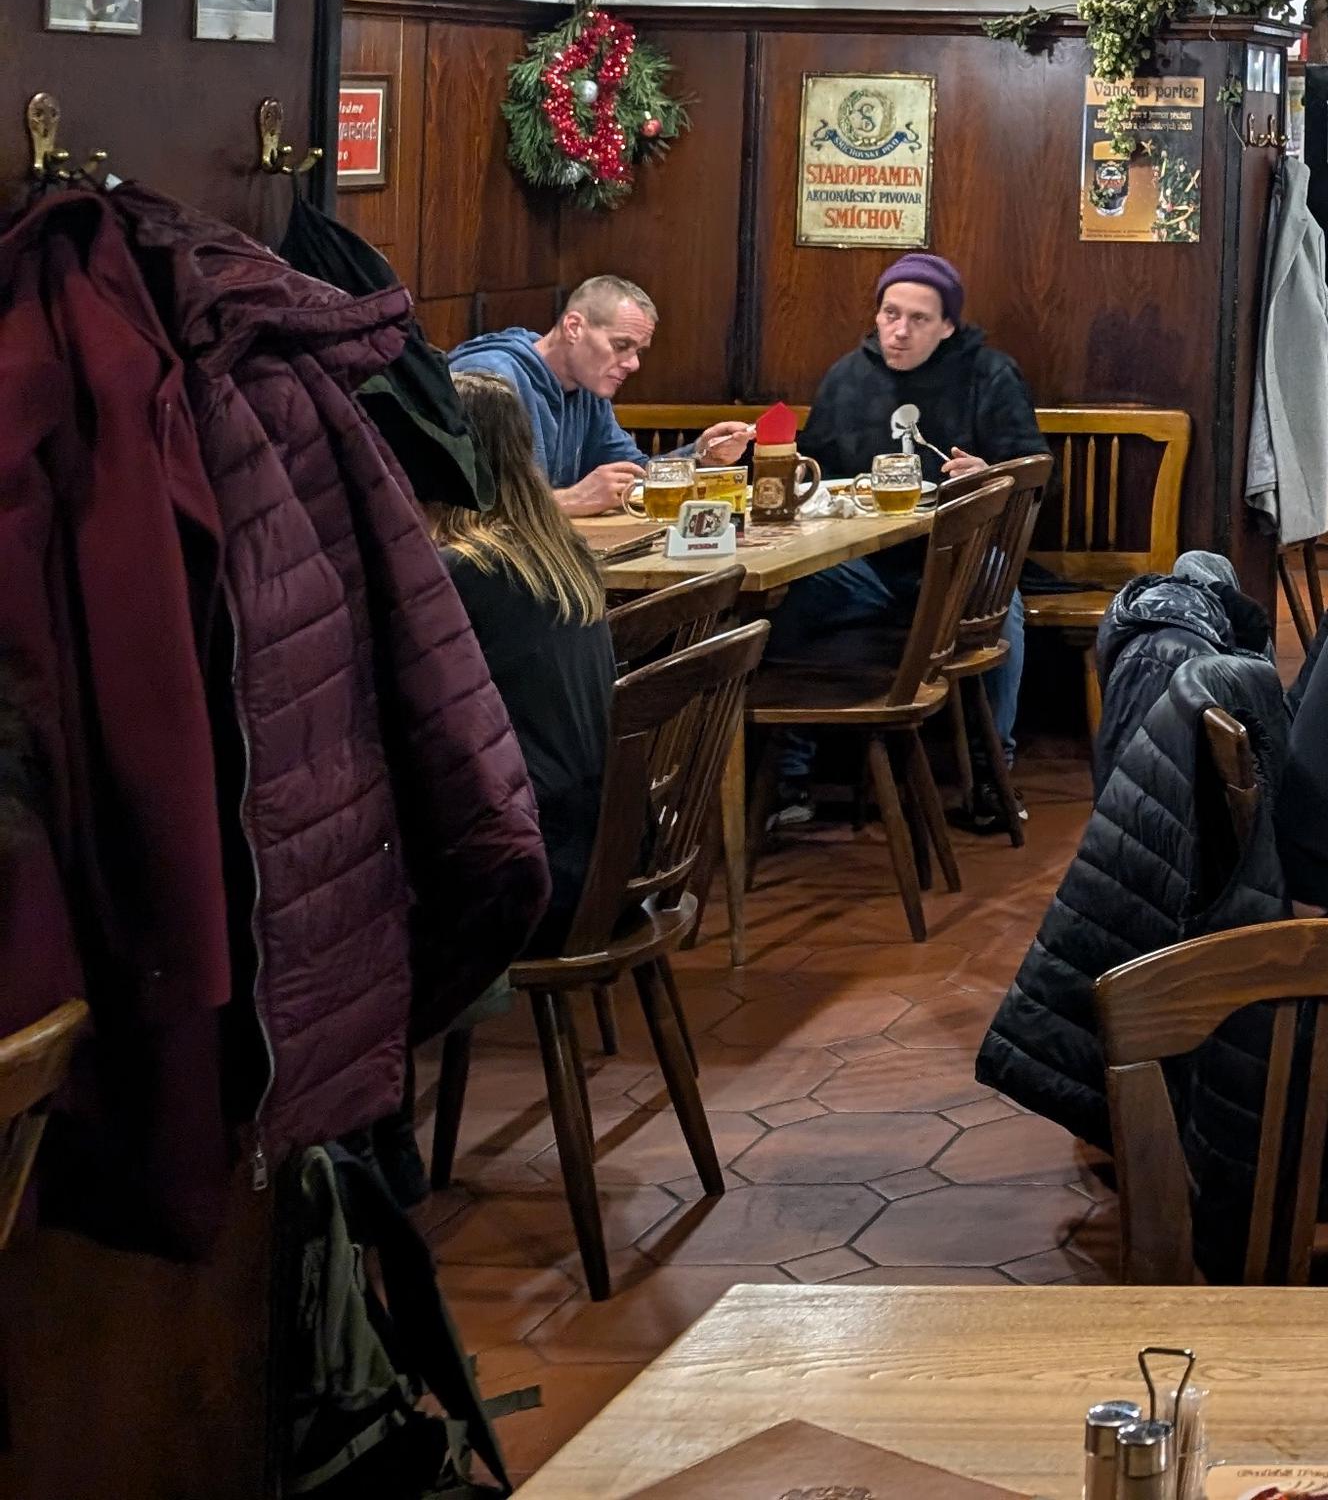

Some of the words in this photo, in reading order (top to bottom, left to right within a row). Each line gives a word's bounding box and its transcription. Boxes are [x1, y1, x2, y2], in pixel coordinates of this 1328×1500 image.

[1155, 83, 1199, 102] porter
[805, 164, 924, 187] STAROPRAMEN
[879, 191, 922, 205] PIVOVAR
[823, 205, 904, 230] SMÍCHOV
